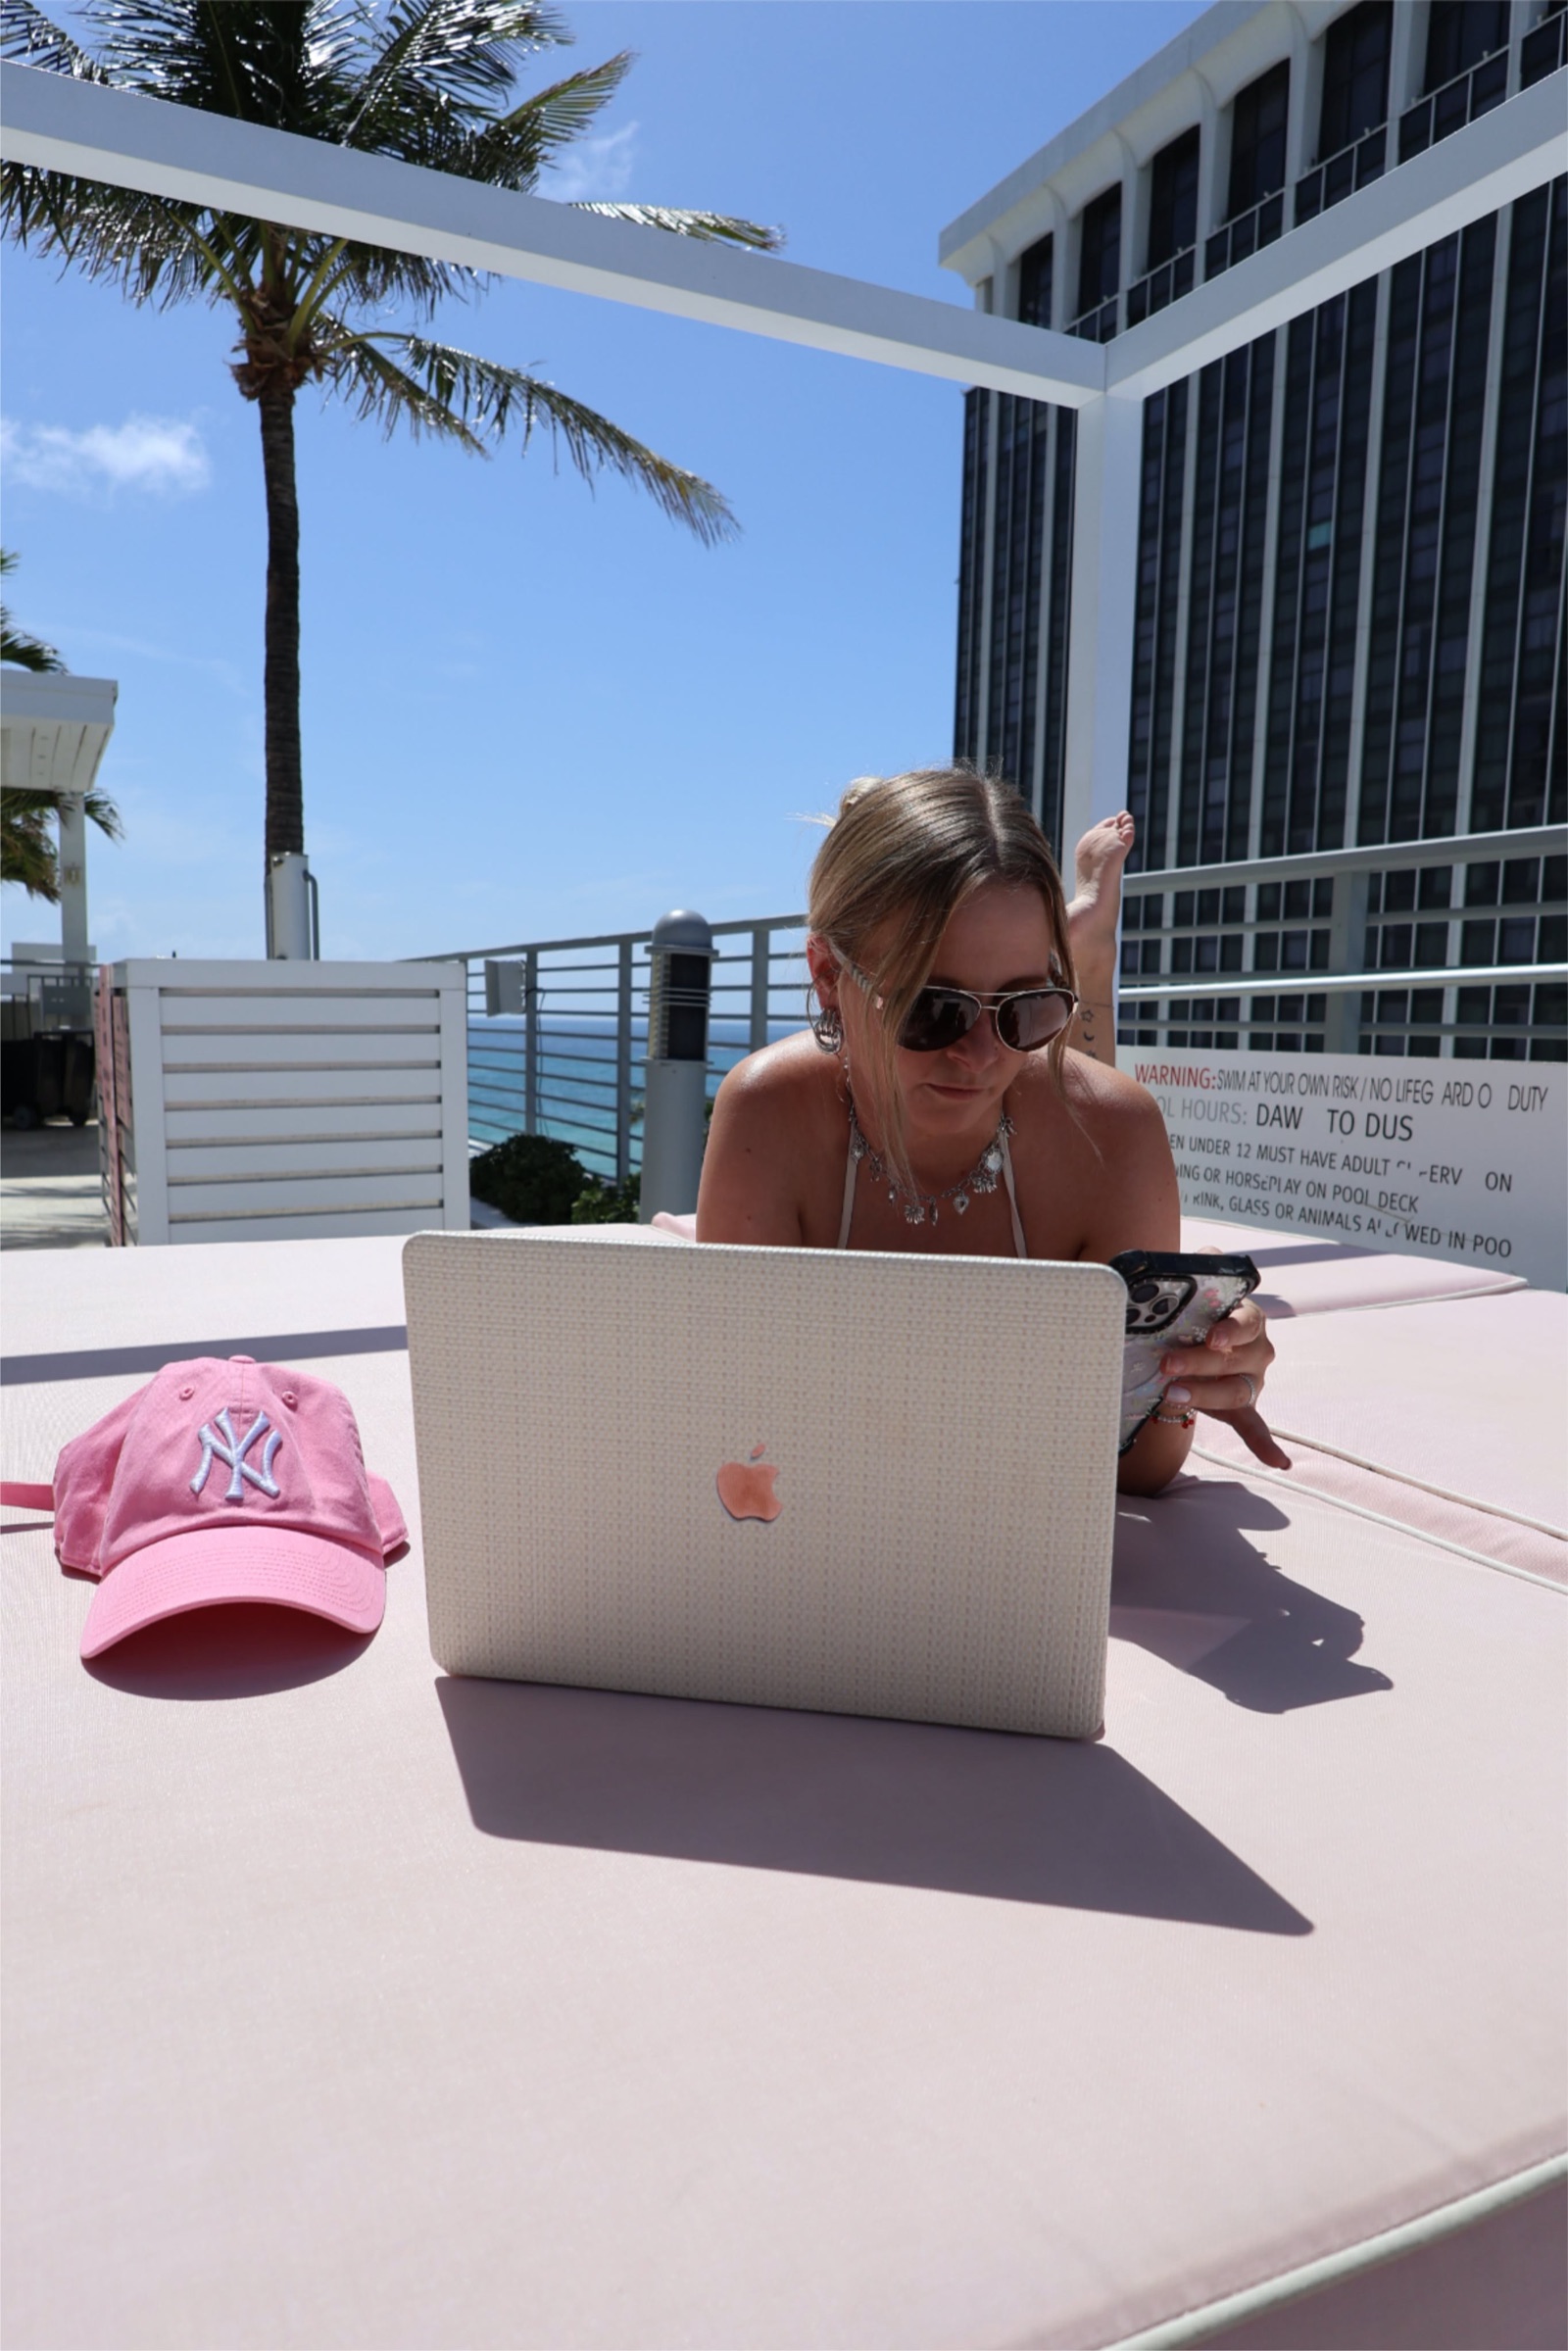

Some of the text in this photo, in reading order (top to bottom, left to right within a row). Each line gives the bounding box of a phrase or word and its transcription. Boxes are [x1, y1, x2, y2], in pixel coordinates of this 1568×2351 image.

[1135, 1064, 1216, 1090] WARNING:
[1217, 1069, 1246, 1091] SWIM
[1248, 1070, 1261, 1093] AT
[1263, 1071, 1295, 1095] YOUR
[1298, 1073, 1330, 1097] OWN
[1333, 1075, 1359, 1100] RISK
[1370, 1077, 1392, 1102] NO
[1396, 1079, 1473, 1107] LIFEGARD
[1507, 1085, 1548, 1112] DUTY
[1156, 1096, 1413, 1142] OL HOURS: DAW TO DUS
[1189, 1136, 1231, 1156] UNDER
[1237, 1143, 1251, 1159] 12
[1256, 1144, 1295, 1164] MUST
[1300, 1149, 1337, 1170] HAVE
[1341, 1153, 1391, 1177] ADULT
[1203, 1166, 1221, 1184] OR
[1305, 1180, 1327, 1199] ON
[1378, 1191, 1419, 1213] DECK
[1229, 1196, 1270, 1217] GLASS
[1275, 1202, 1294, 1221] OR
[1298, 1205, 1361, 1232] ANIMALS
[1448, 1230, 1466, 1250] IN
[1472, 1234, 1512, 1258] POO
[189, 1406, 283, 1499] NY
